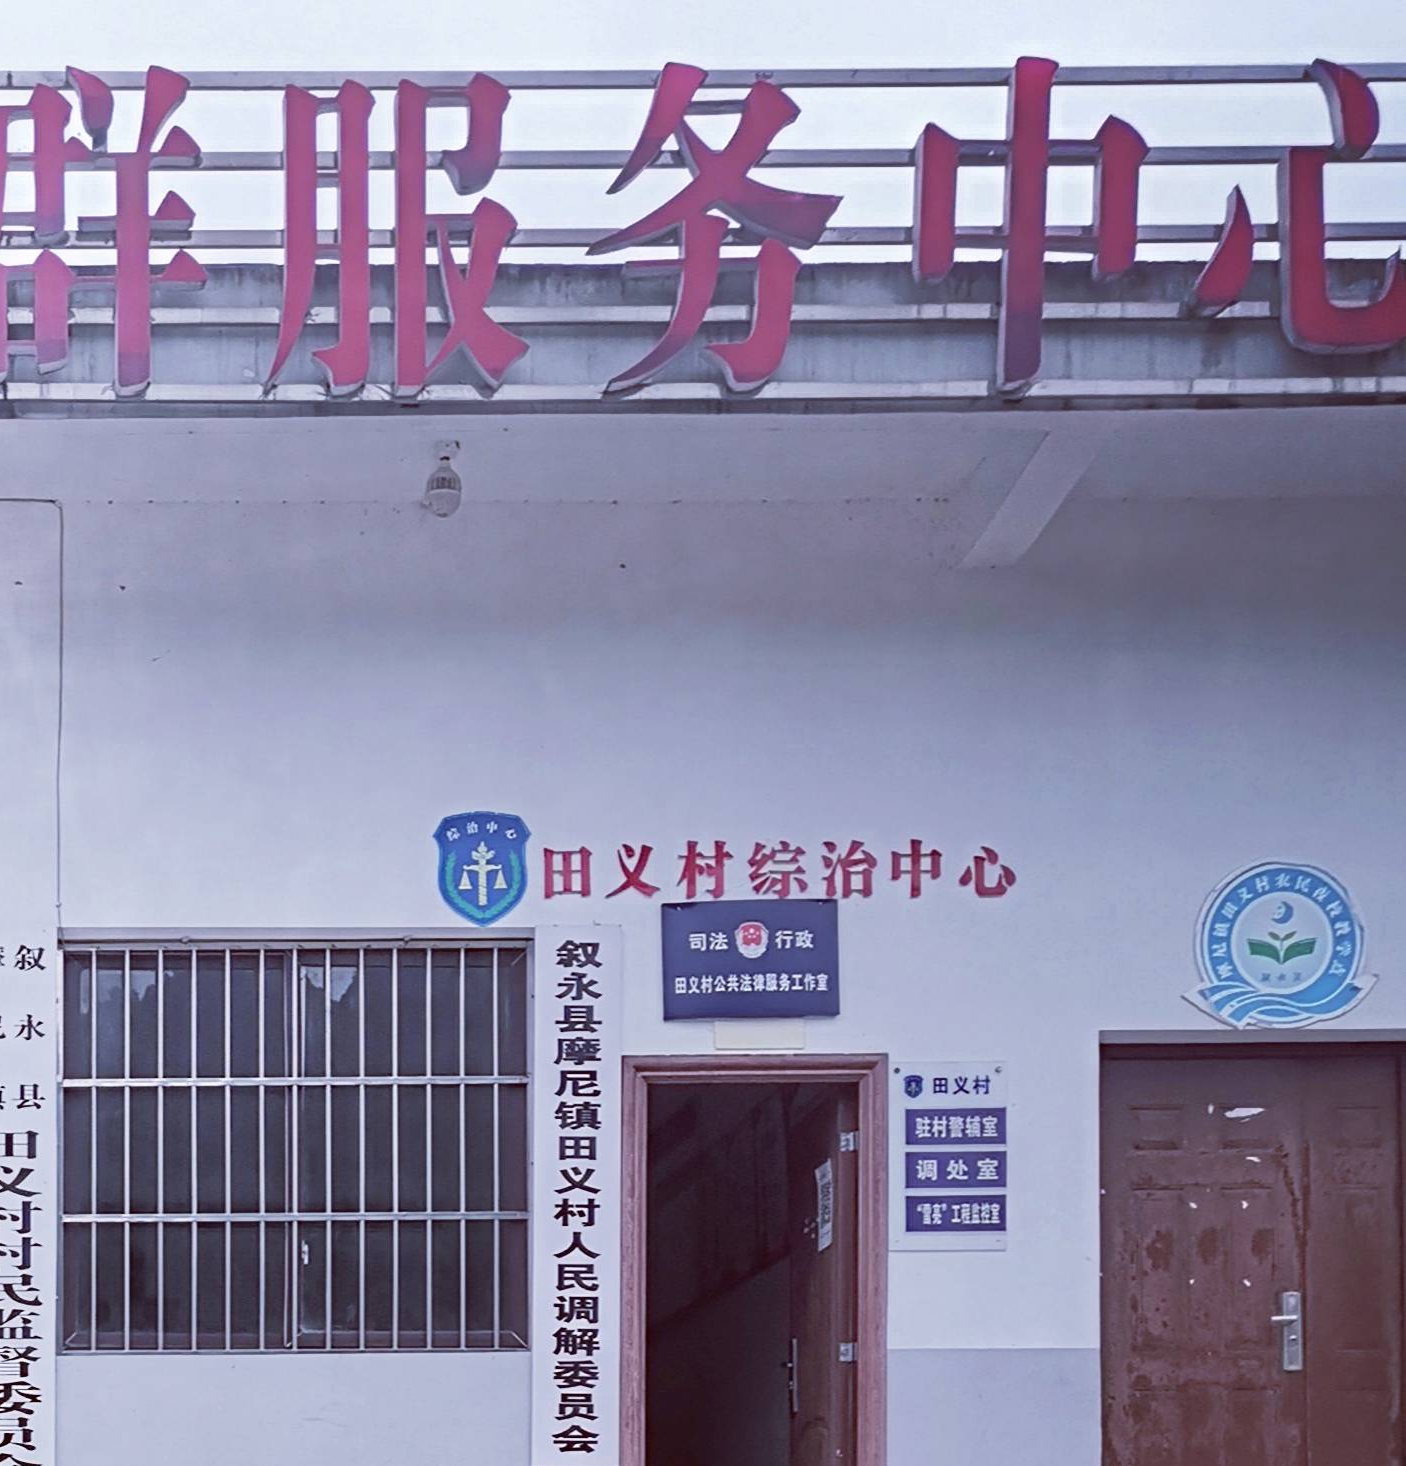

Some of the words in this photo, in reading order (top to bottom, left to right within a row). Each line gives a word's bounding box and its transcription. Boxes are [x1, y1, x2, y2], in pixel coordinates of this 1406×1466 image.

[542, 838, 1016, 900] 田义村综治中心
[688, 931, 729, 952] 司法
[774, 929, 814, 949] 行政
[674, 973, 829, 994] 田义村公共法律服务工作室
[12, 944, 47, 1110] 叙永县
[933, 1075, 991, 1095] 田义村
[916, 1158, 999, 1181] 调处室
[553, 939, 603, 1454] 叙永县摩尼镇田义村人民调解委员会
